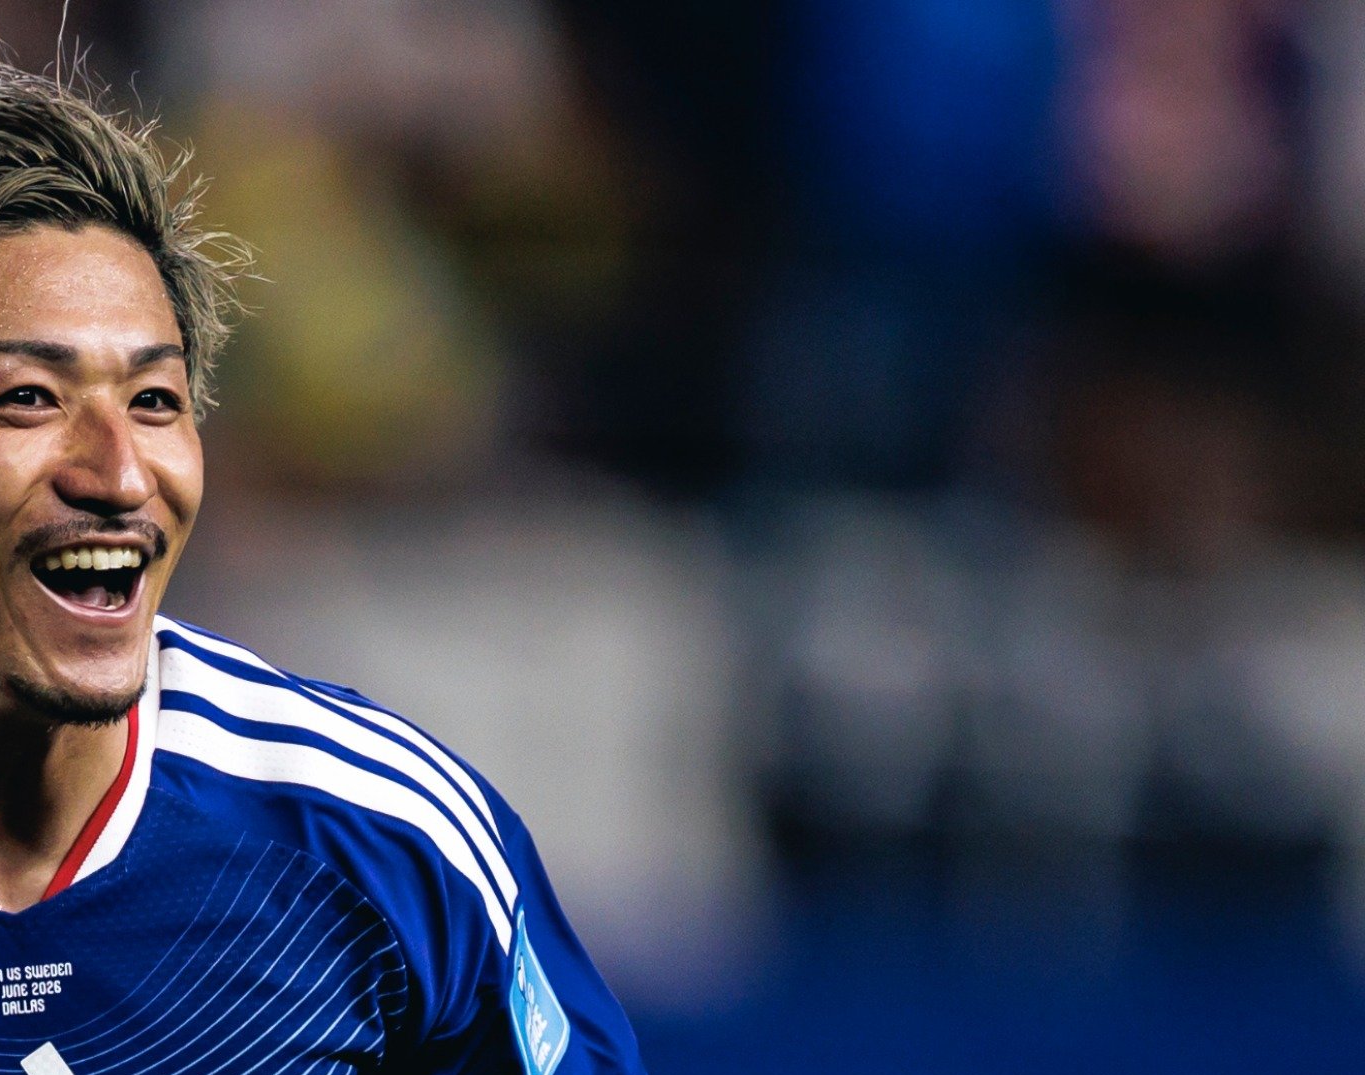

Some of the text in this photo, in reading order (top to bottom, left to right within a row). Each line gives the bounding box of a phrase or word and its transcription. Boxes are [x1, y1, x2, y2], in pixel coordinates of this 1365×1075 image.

[6, 966, 21, 981] VS
[24, 962, 73, 980] SWEDEN
[1, 983, 28, 999] JUNE
[31, 980, 62, 996] 2026
[1, 998, 45, 1016] DALLAS
